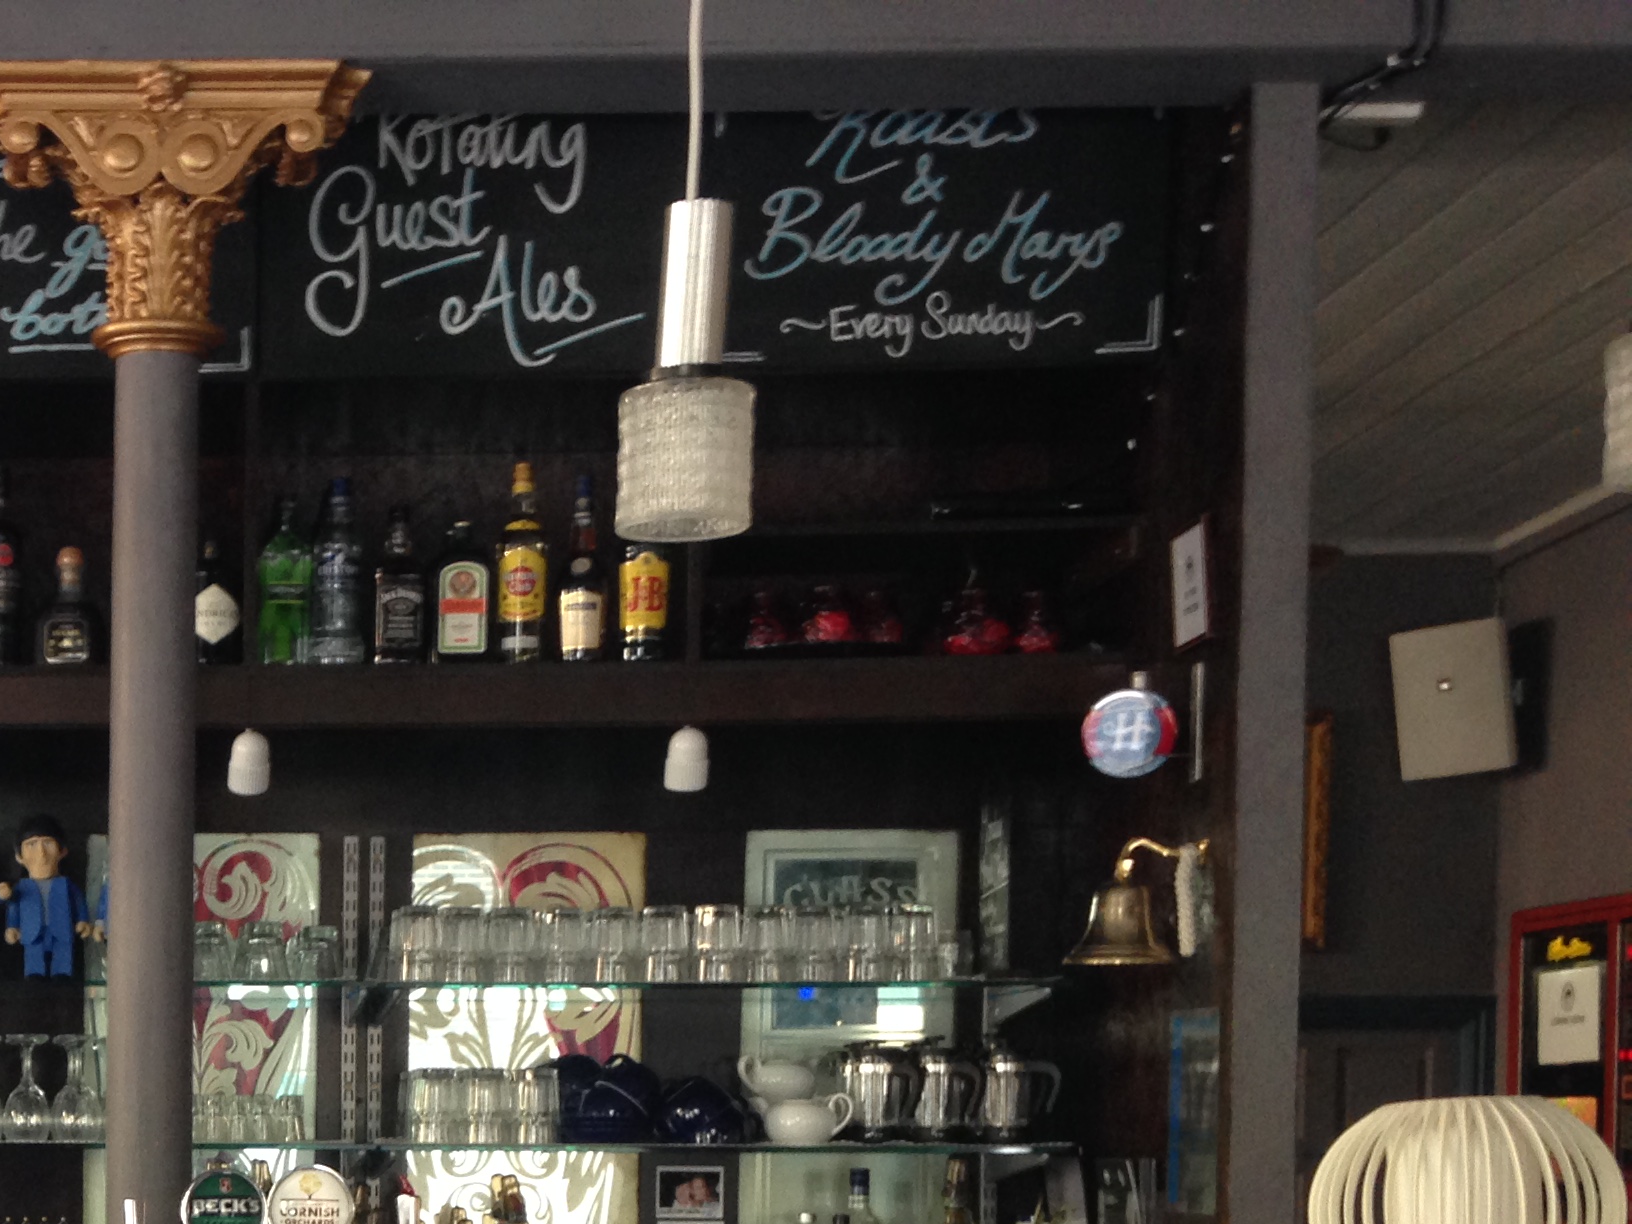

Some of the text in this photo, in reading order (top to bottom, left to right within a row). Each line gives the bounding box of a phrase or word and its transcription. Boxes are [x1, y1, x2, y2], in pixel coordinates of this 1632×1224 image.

[901, 153, 947, 203] &
[305, 164, 492, 338] Guest
[439, 234, 597, 368] Ales
[743, 186, 963, 306] Bloody
[829, 290, 1036, 358] Every Sunday
